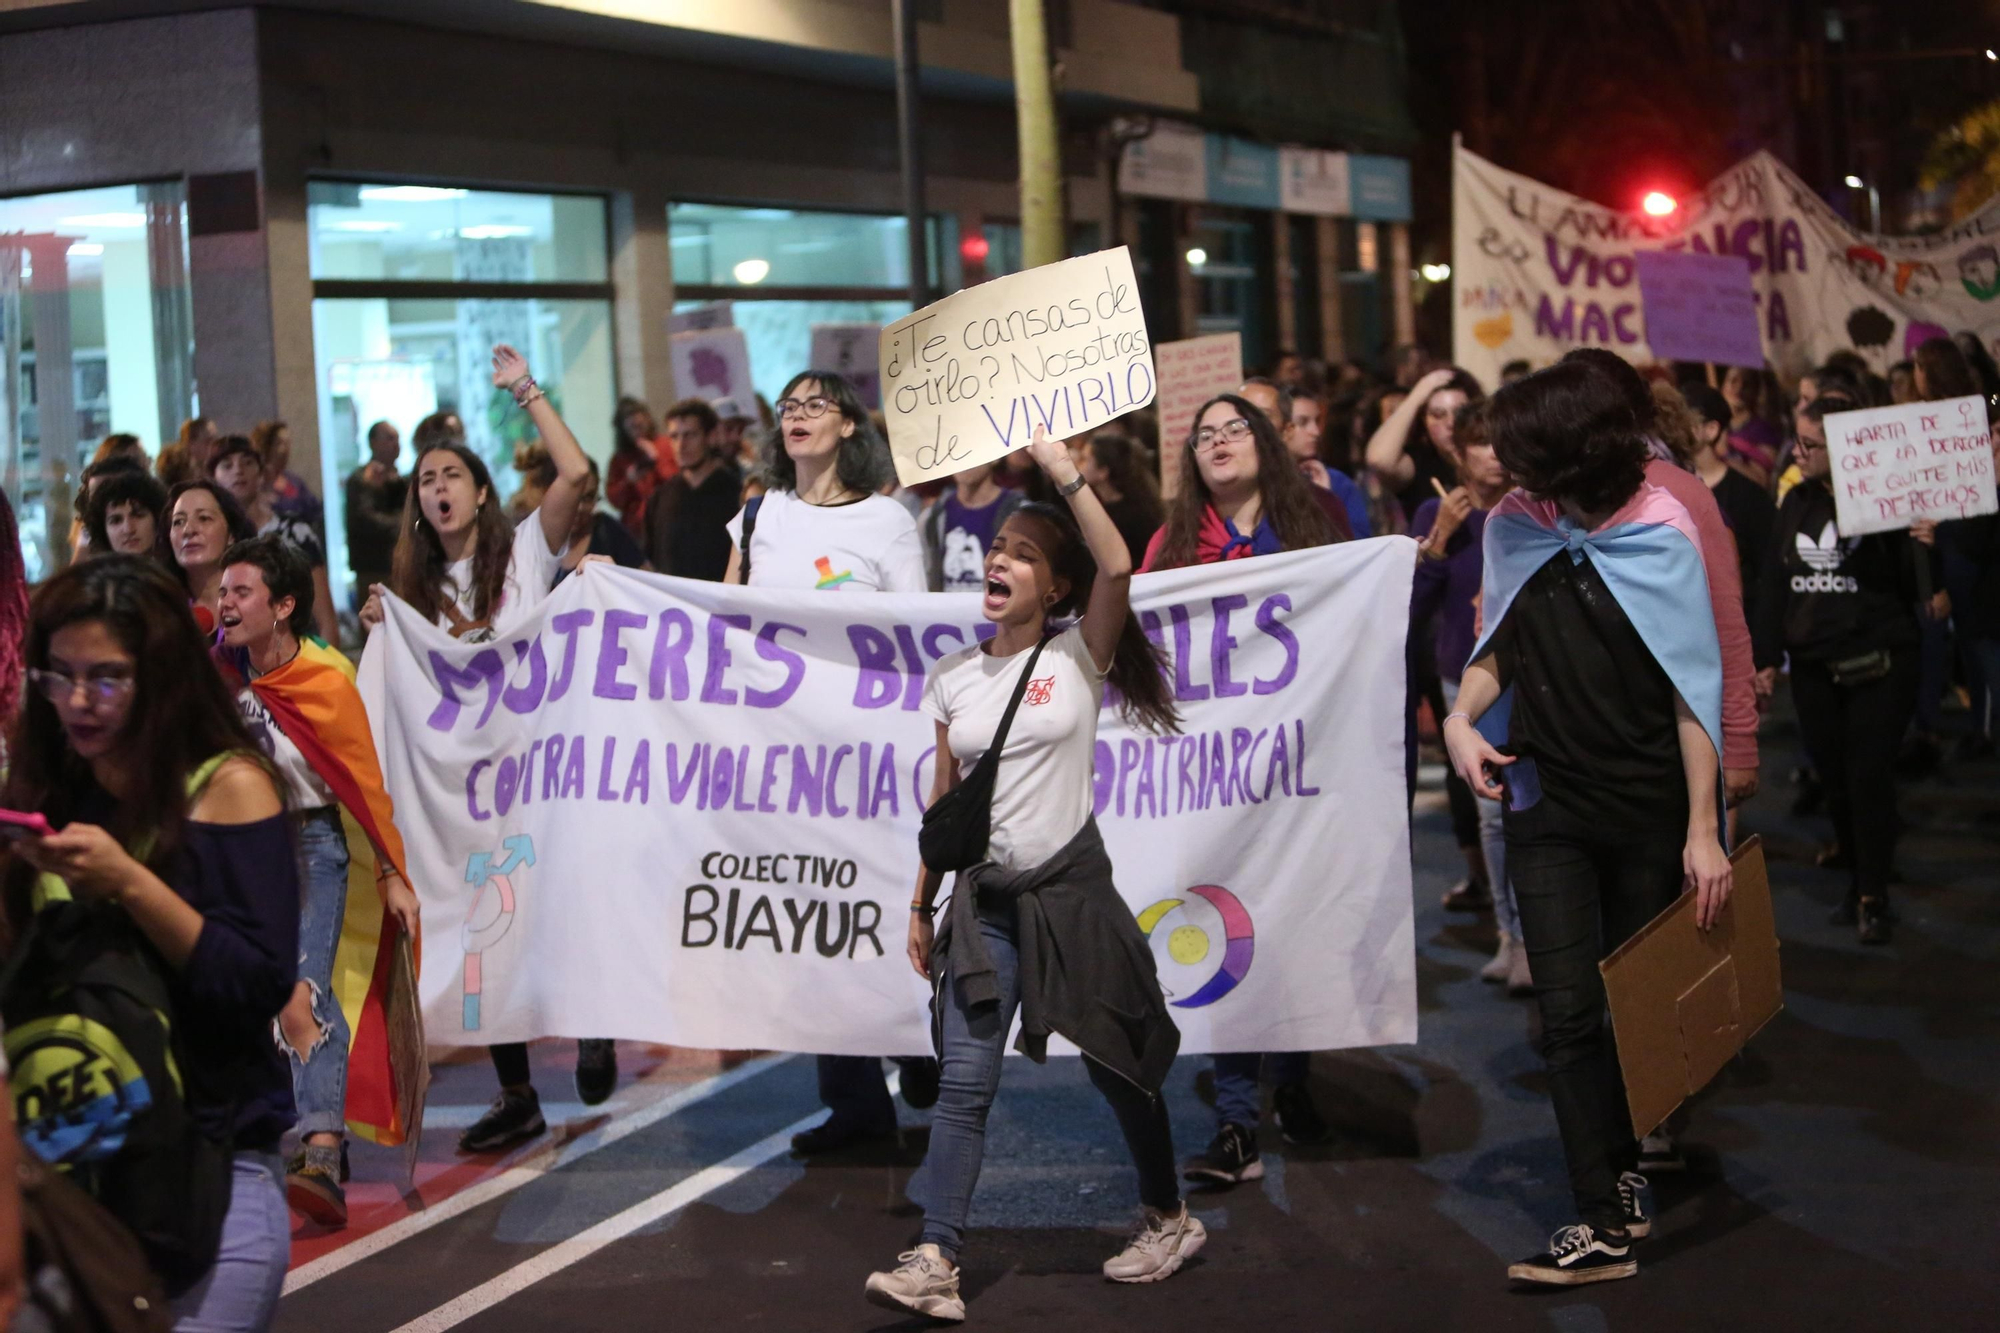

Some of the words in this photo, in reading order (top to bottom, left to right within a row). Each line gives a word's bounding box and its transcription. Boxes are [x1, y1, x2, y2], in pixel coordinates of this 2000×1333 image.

[887, 313, 948, 378] ¿Te
[963, 297, 1092, 351] cansas
[1095, 265, 1137, 320] de
[894, 355, 1000, 414] oirlo?
[1011, 325, 1149, 385] Nosotras
[915, 414, 973, 471] de
[980, 361, 1151, 447] VIVIRLO
[1841, 450, 1879, 472] QUE
[1896, 444, 1917, 460] LA
[1928, 432, 1990, 454] DERECHA
[1845, 421, 1906, 446] HARTA
[1920, 414, 1939, 431] DE
[1847, 475, 1874, 499] ME
[1885, 465, 1948, 491] QUITE
[1957, 457, 1988, 477] MIS
[1790, 572, 1858, 593] addas
[426, 607, 807, 731] MUJERES
[597, 734, 650, 805] LA
[666, 741, 900, 820] VIOLENCIA
[700, 851, 858, 889] COLECTIVO
[681, 883, 885, 959] BIAYUR
